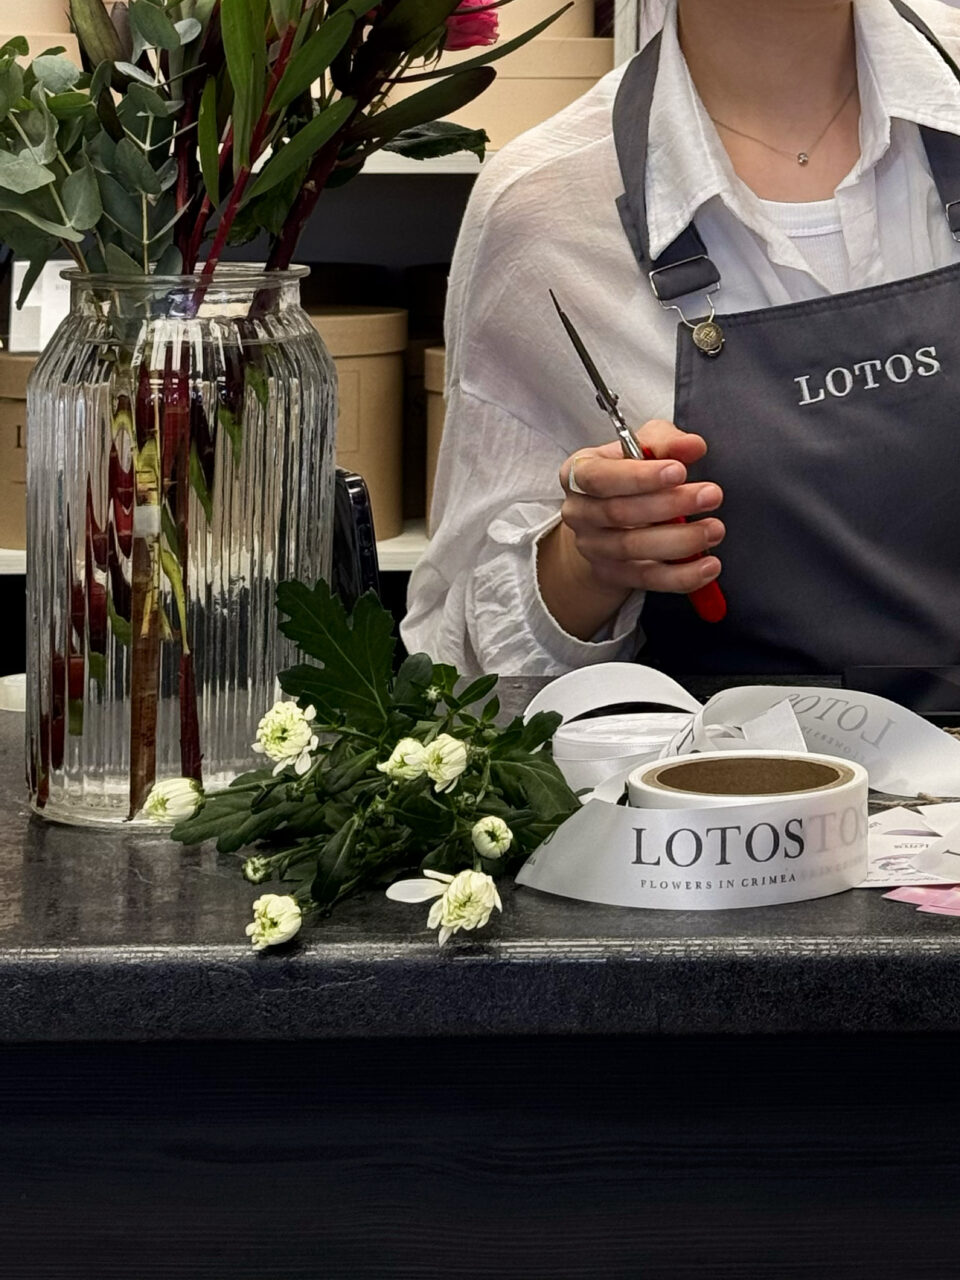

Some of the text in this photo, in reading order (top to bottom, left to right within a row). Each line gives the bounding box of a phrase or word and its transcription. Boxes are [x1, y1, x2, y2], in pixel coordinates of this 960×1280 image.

[793, 346, 941, 406] LOTOS
[631, 817, 805, 868] LOTOS
[640, 873, 797, 890] FLOWERS IN CRIMEA
